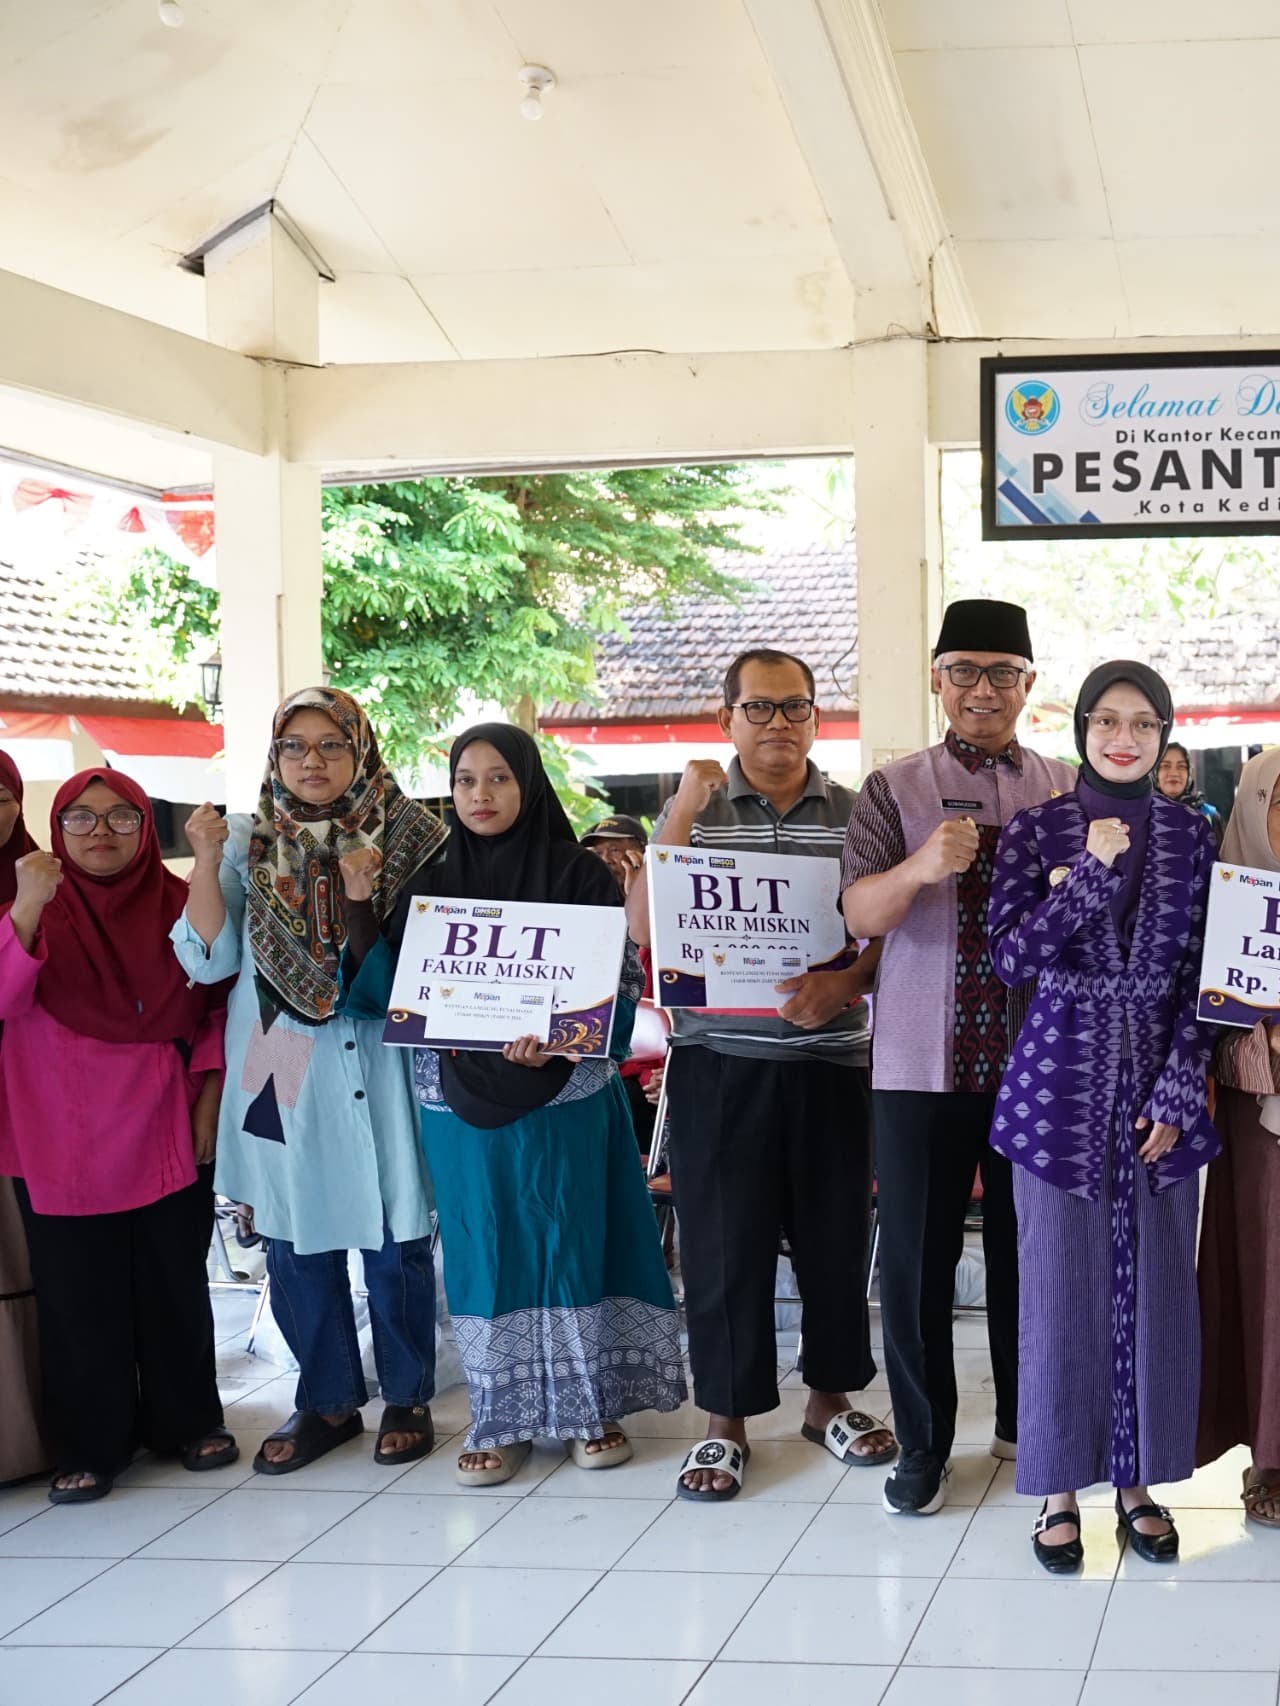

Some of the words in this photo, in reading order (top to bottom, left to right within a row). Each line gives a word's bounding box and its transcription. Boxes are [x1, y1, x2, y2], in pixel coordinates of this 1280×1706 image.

[1079, 382, 1223, 427] Selamat
[1116, 428, 1137, 444] Di
[1144, 428, 1214, 444] Kantor
[1139, 499, 1206, 515] Kota
[673, 854, 704, 866] Mapan
[1239, 874, 1273, 888] Mapan
[688, 873, 790, 914] BLT
[434, 904, 467, 915] Mapan
[677, 913, 738, 932] FAKIR
[743, 916, 811, 935] MISKIN
[440, 922, 560, 962] BLT
[421, 958, 488, 977] FAKIR
[494, 962, 577, 981] MISKIN
[1225, 966, 1268, 995] Rp.
